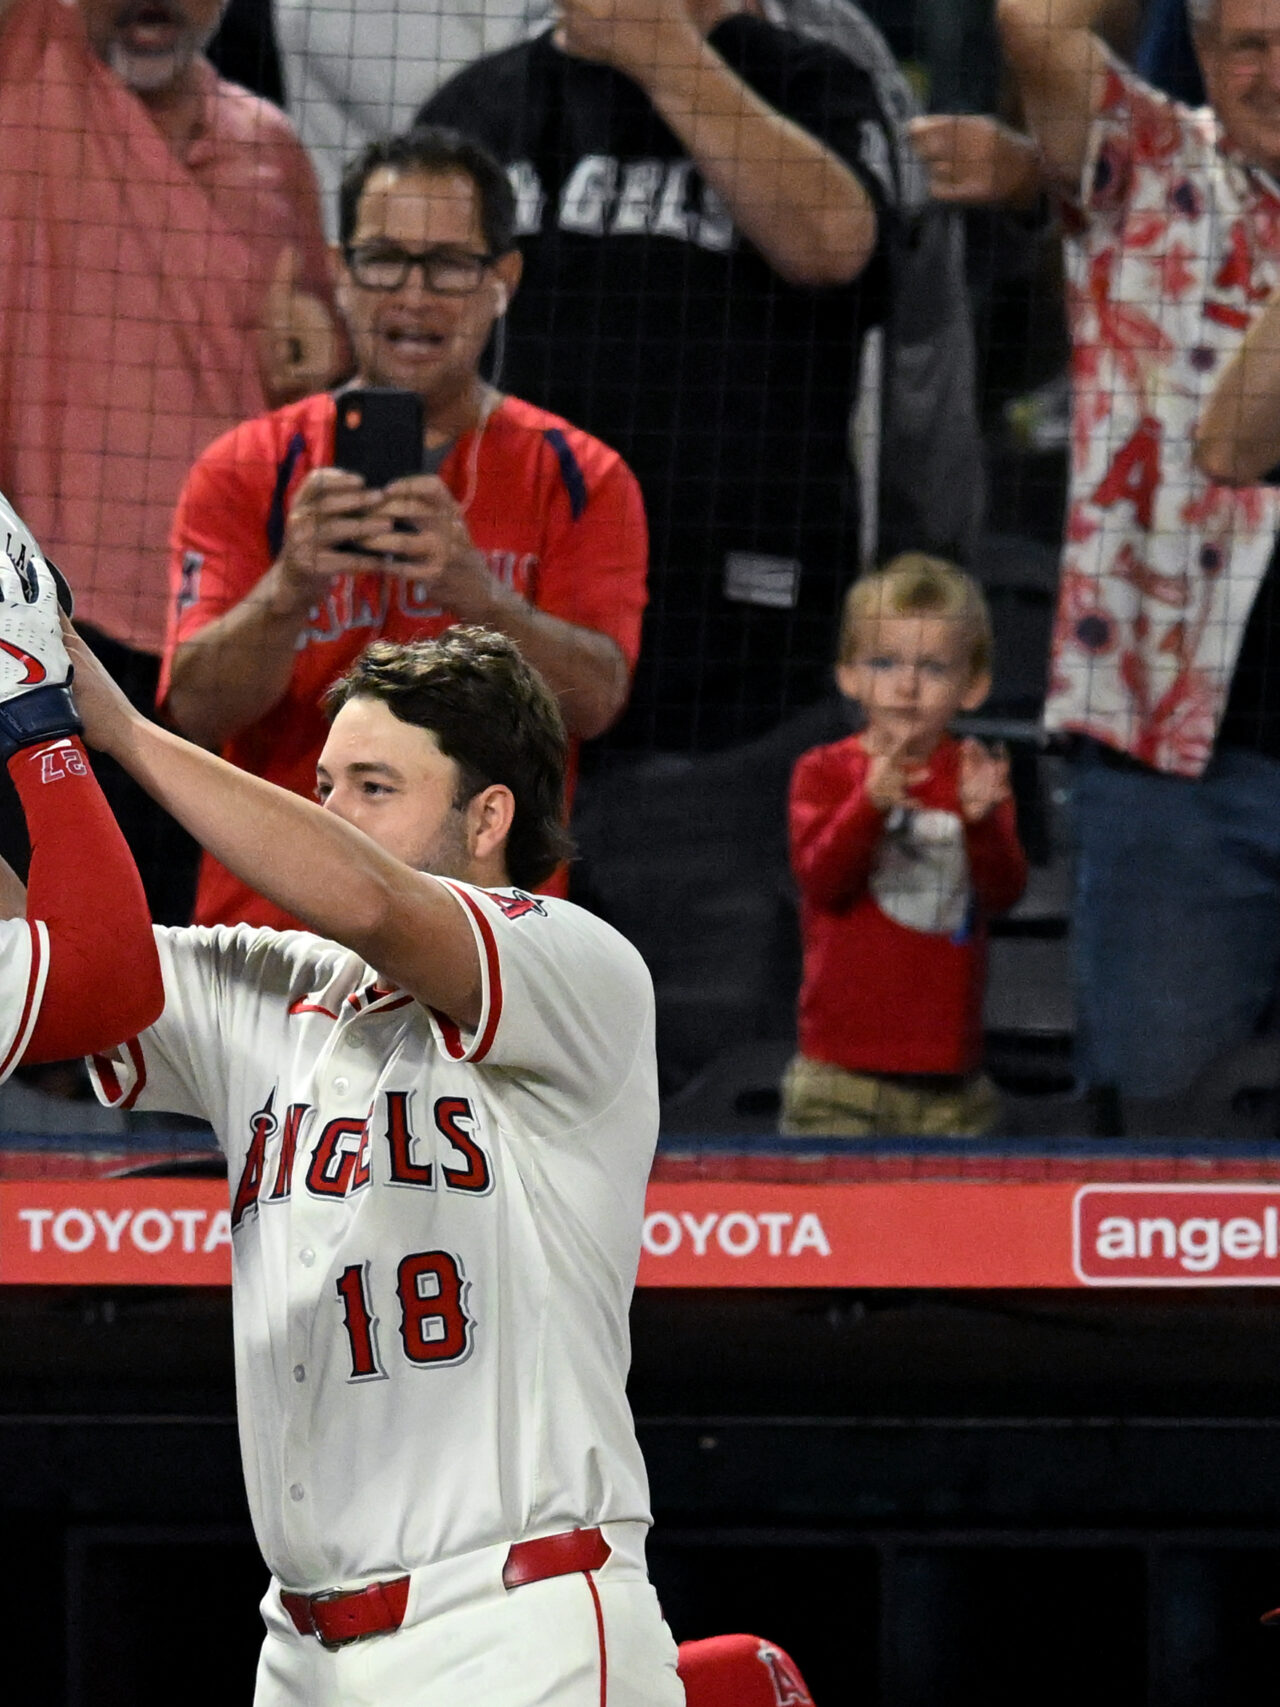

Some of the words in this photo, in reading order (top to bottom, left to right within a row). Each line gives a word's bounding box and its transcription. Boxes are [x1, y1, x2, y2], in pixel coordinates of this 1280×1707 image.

[19, 1208, 232, 1252] TOYOTA
[642, 1212, 831, 1256] OYOTA
[336, 1250, 476, 1384] 18
